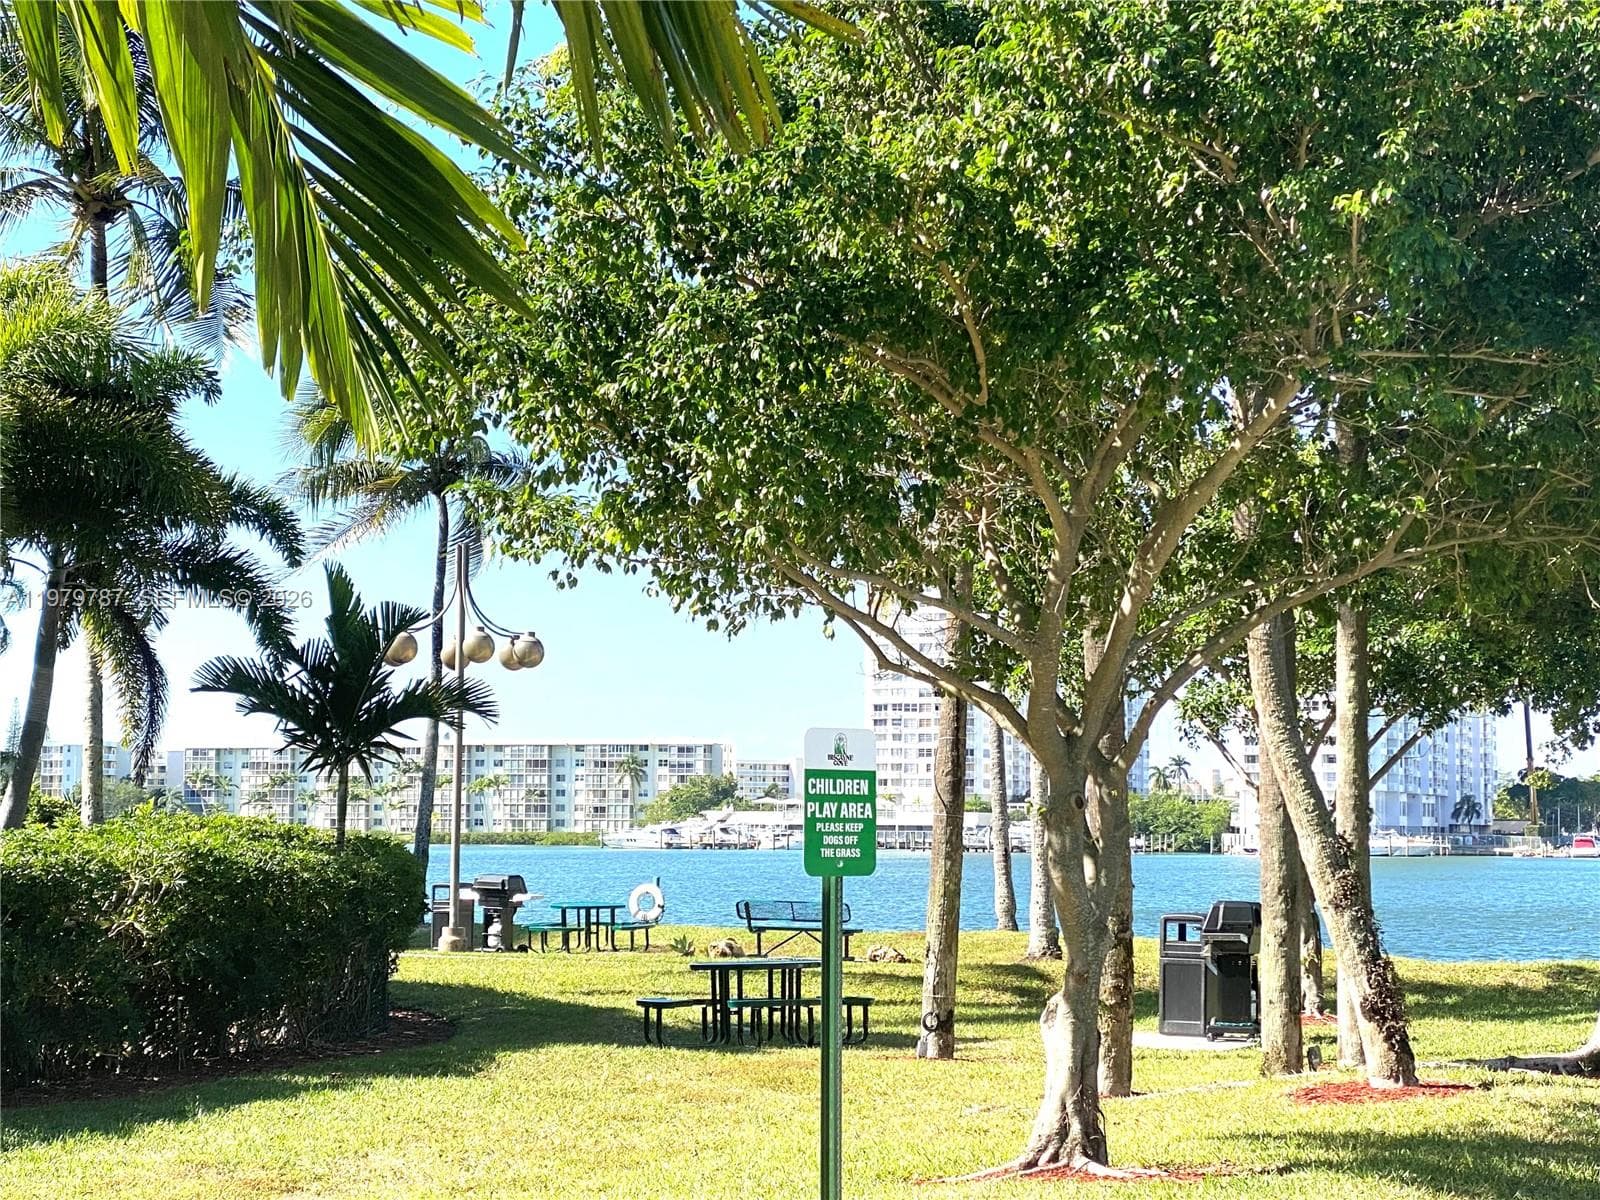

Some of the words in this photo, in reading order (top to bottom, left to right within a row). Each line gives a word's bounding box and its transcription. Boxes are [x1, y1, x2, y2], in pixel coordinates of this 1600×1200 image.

[807, 778, 868, 795] CHILDREN
[807, 801, 838, 819] PLAY
[840, 802, 873, 819] AREA
[816, 822, 844, 832] PLEASE
[845, 822, 864, 833] KEEP
[823, 835, 843, 845] DOGS
[844, 835, 858, 845] OFF
[820, 848, 834, 858] THE
[835, 848, 861, 858] GRASS
